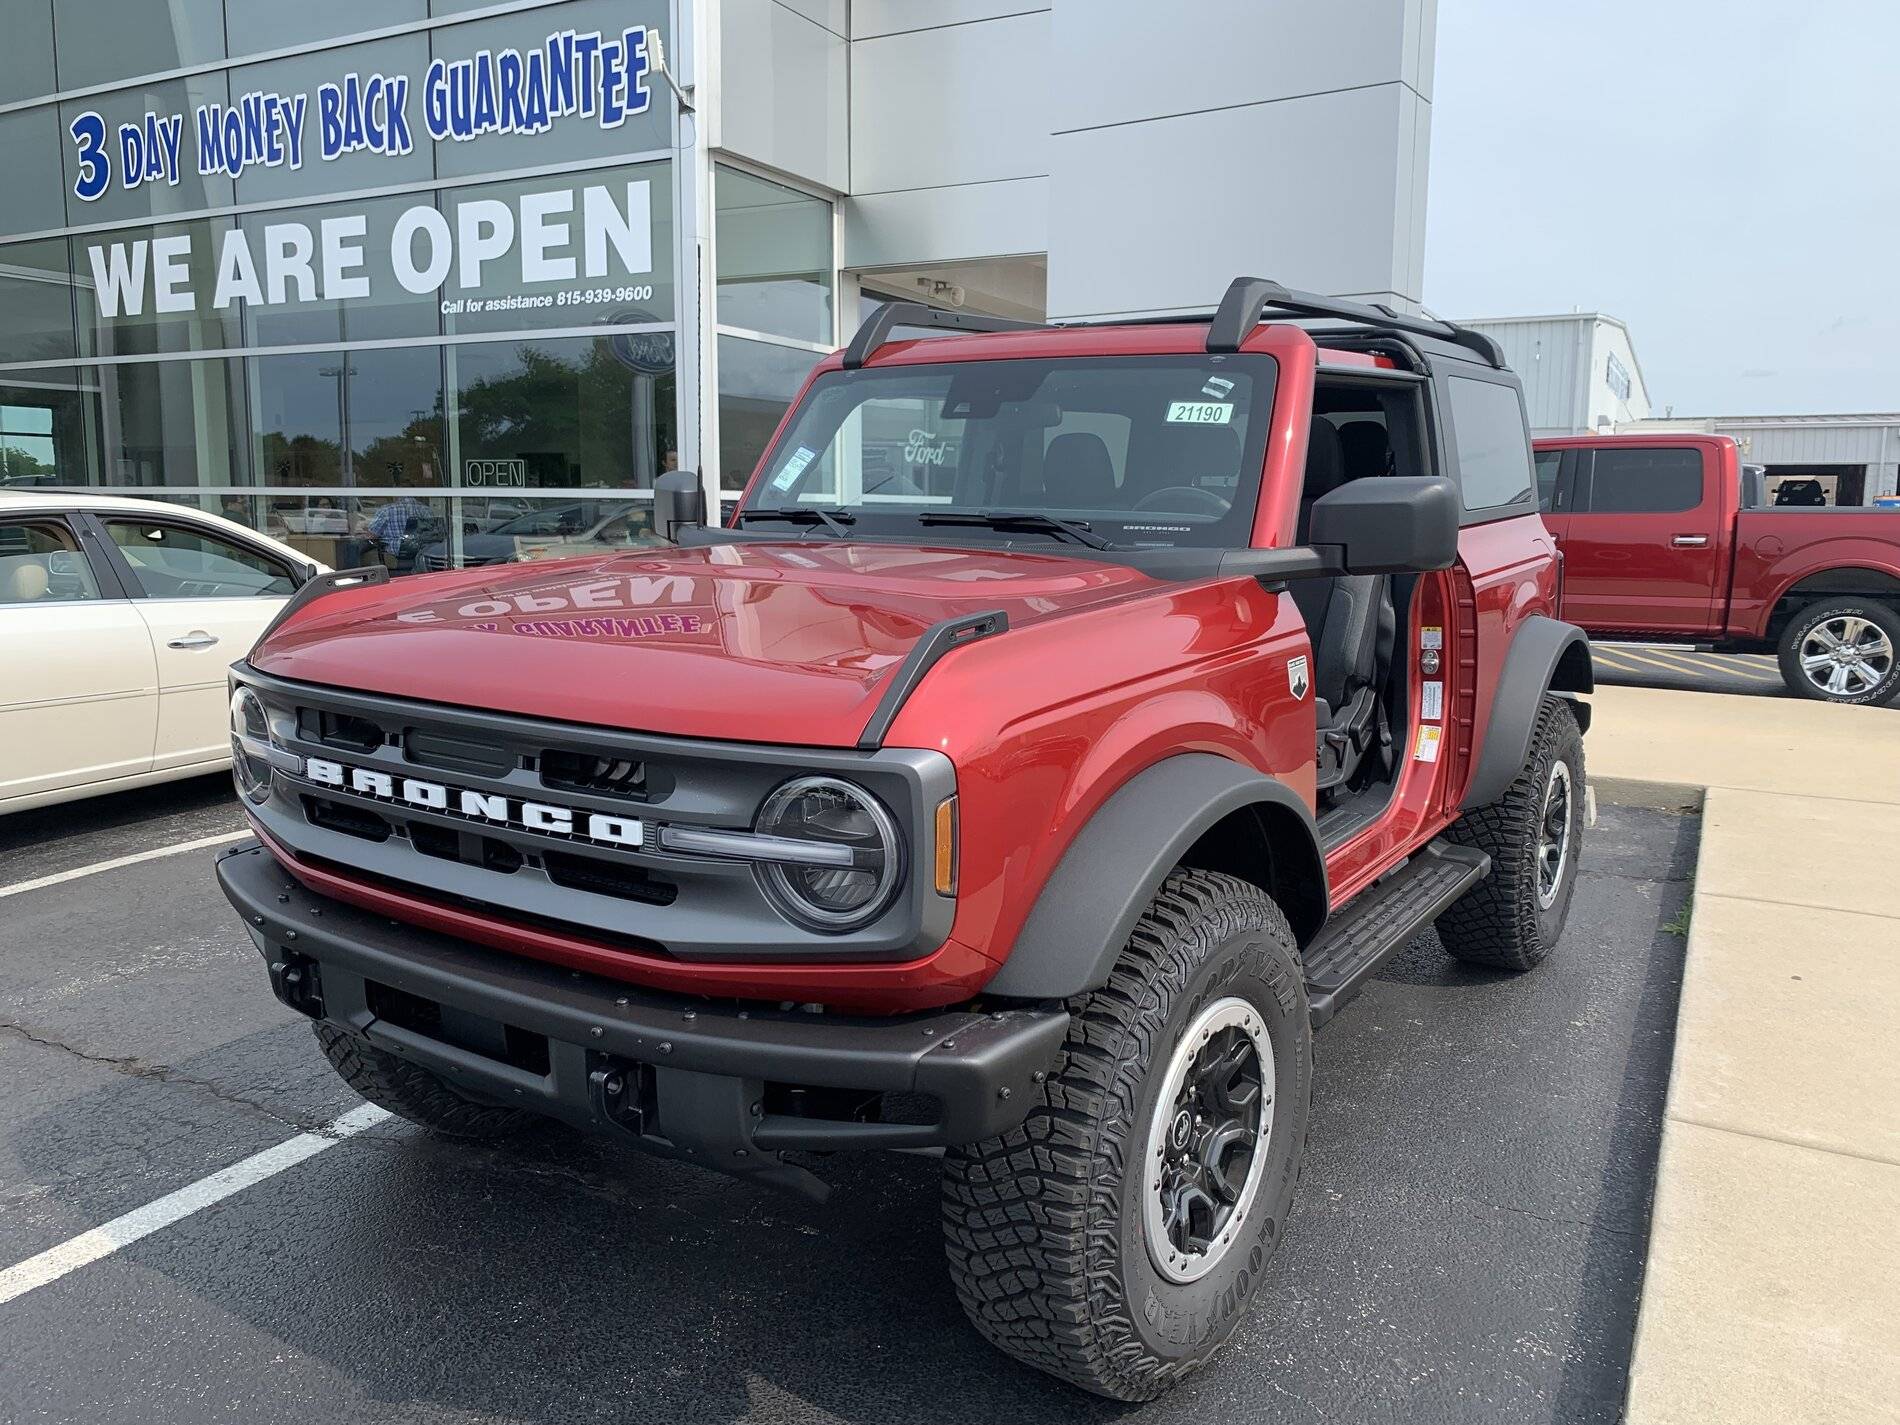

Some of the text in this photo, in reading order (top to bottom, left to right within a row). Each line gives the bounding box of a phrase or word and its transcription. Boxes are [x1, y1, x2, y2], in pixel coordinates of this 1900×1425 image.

[70, 25, 651, 201] 3 DAY MONEY BACK GUARANTEE
[88, 180, 652, 317] WE ARE OPEN
[441, 285, 653, 314] Call for assistance 815-939-9600
[1175, 405, 1222, 422] 21190
[905, 430, 946, 465] Ford
[468, 462, 522, 486] OPEN
[307, 757, 643, 846] BRONCO
